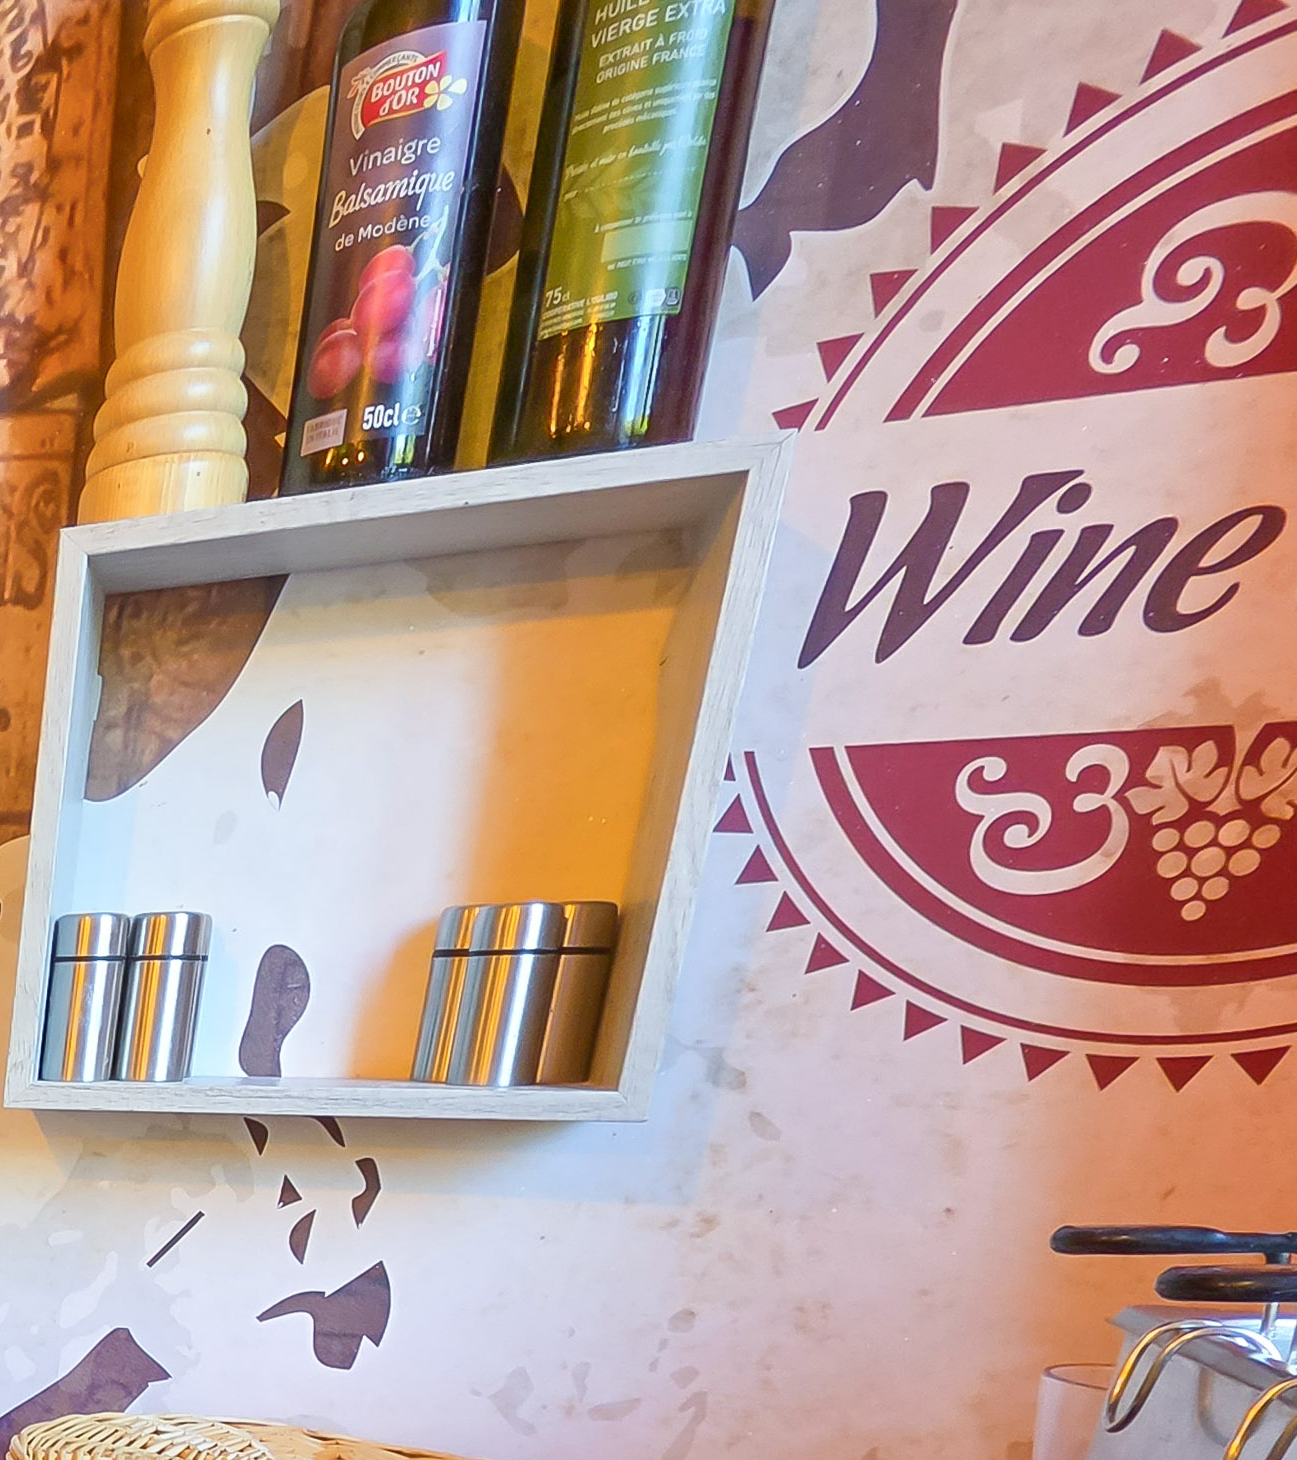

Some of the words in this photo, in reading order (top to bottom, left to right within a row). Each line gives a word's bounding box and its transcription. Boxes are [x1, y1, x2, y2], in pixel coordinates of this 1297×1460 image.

[591, 8, 660, 48] VIERGE
[664, 0, 726, 23] EXTRA
[595, 56, 649, 84] ORIGINE
[652, 44, 706, 65] FRANCE
[598, 38, 654, 69] EXTRAIT
[668, 28, 708, 45] FROID
[370, 61, 442, 103] BOUTON
[349, 136, 442, 177] Vinaigre
[328, 169, 455, 229] Balsamique
[335, 233, 354, 252] de
[357, 214, 431, 243] Modène
[545, 287, 563, 308] 75
[362, 402, 400, 430] 50cl
[798, 469, 1288, 671] Wine
